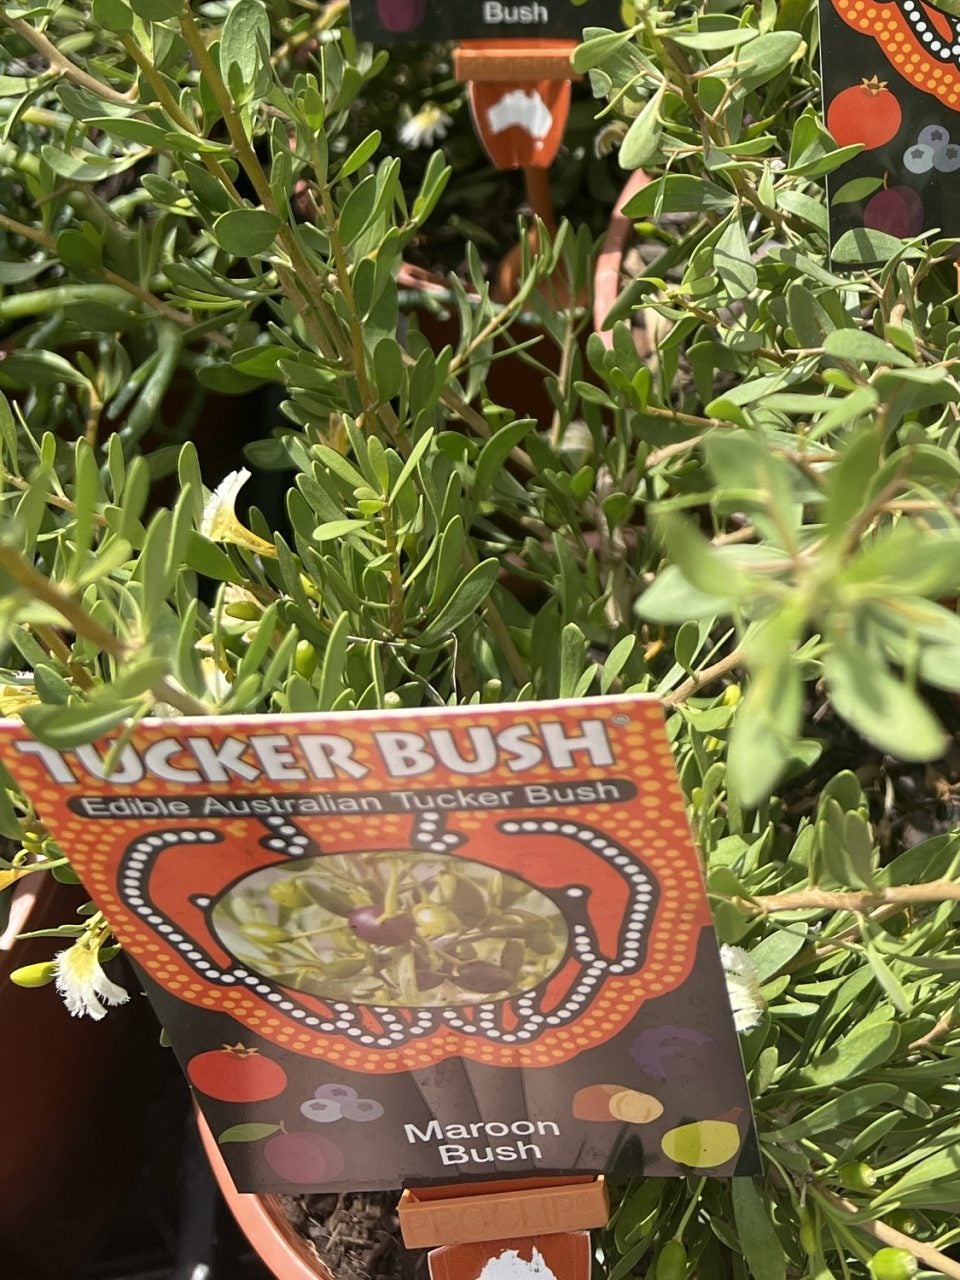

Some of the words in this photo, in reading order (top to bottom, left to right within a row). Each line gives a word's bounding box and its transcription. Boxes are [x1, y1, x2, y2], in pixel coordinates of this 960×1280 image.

[483, 1, 549, 24] Bush
[12, 733, 371, 785] TUCKER
[79, 795, 190, 817] Edible
[203, 791, 382, 817] Australian
[391, 787, 514, 812] Tucker
[524, 782, 619, 805] Bush
[403, 1119, 561, 1144] Maroon
[438, 1140, 543, 1166] Bush
